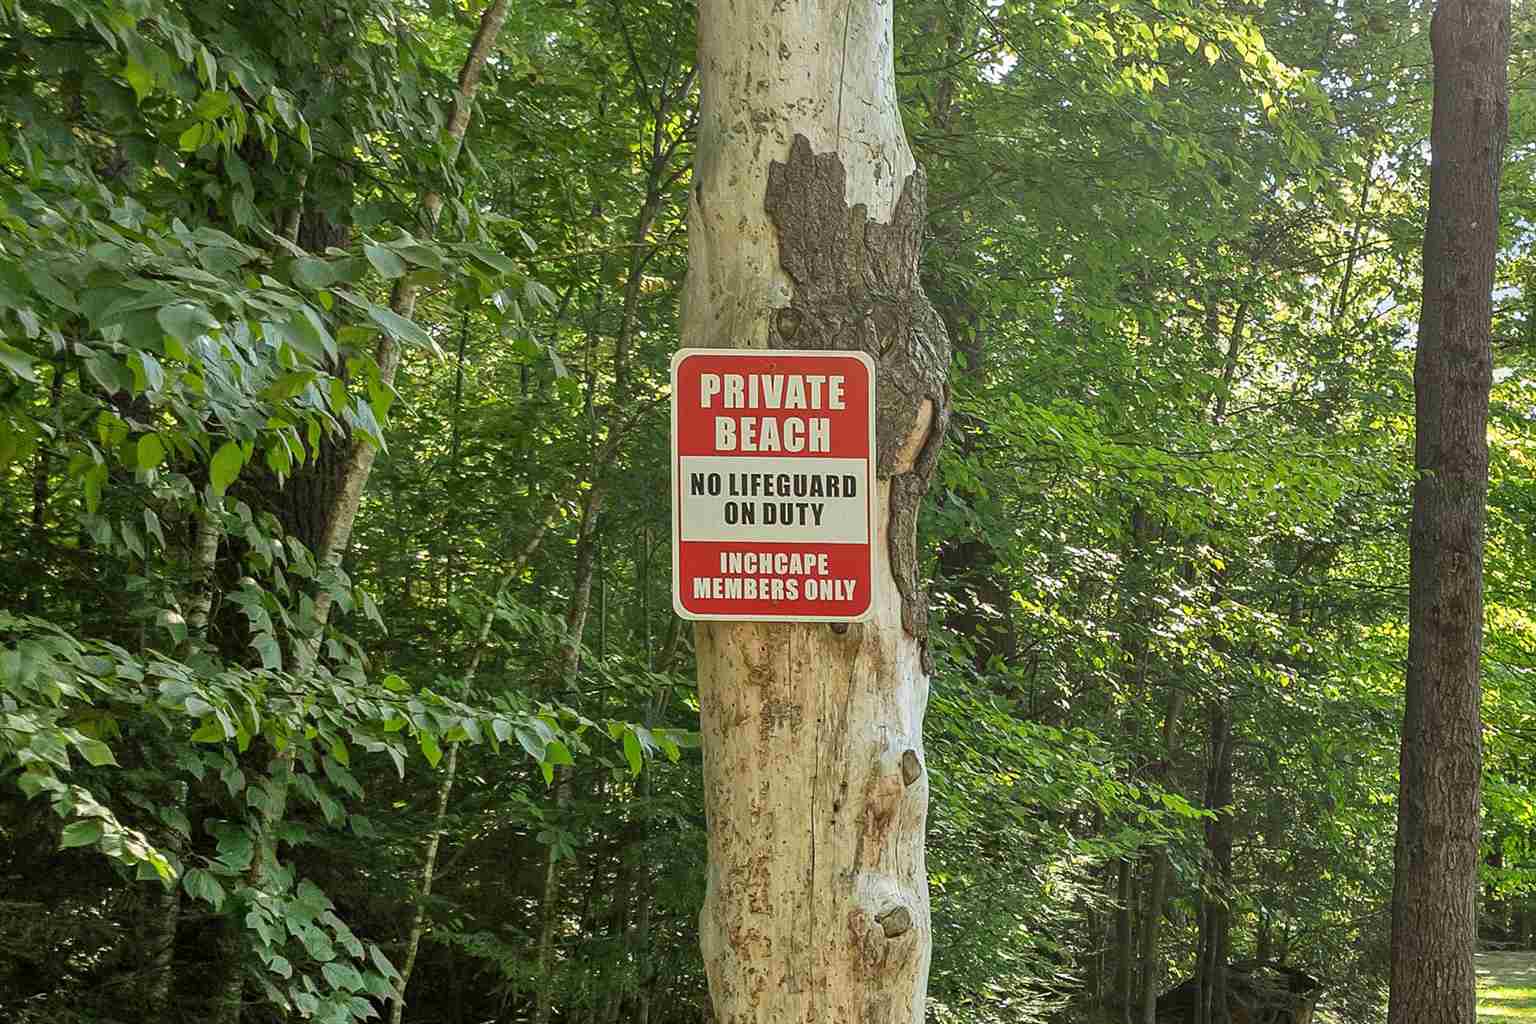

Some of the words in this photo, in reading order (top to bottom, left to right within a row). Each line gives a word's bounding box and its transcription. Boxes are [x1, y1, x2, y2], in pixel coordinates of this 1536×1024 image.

[700, 373, 846, 410] PRIVATE
[714, 415, 831, 453] BEACH
[690, 472, 721, 496] NO
[729, 474, 857, 498] LIFEGUARD
[724, 501, 755, 524] ON
[763, 502, 825, 526] DUTY
[719, 552, 829, 575] INCHCAPE
[693, 577, 799, 600] MEMBERS
[803, 579, 857, 601] ONLY
